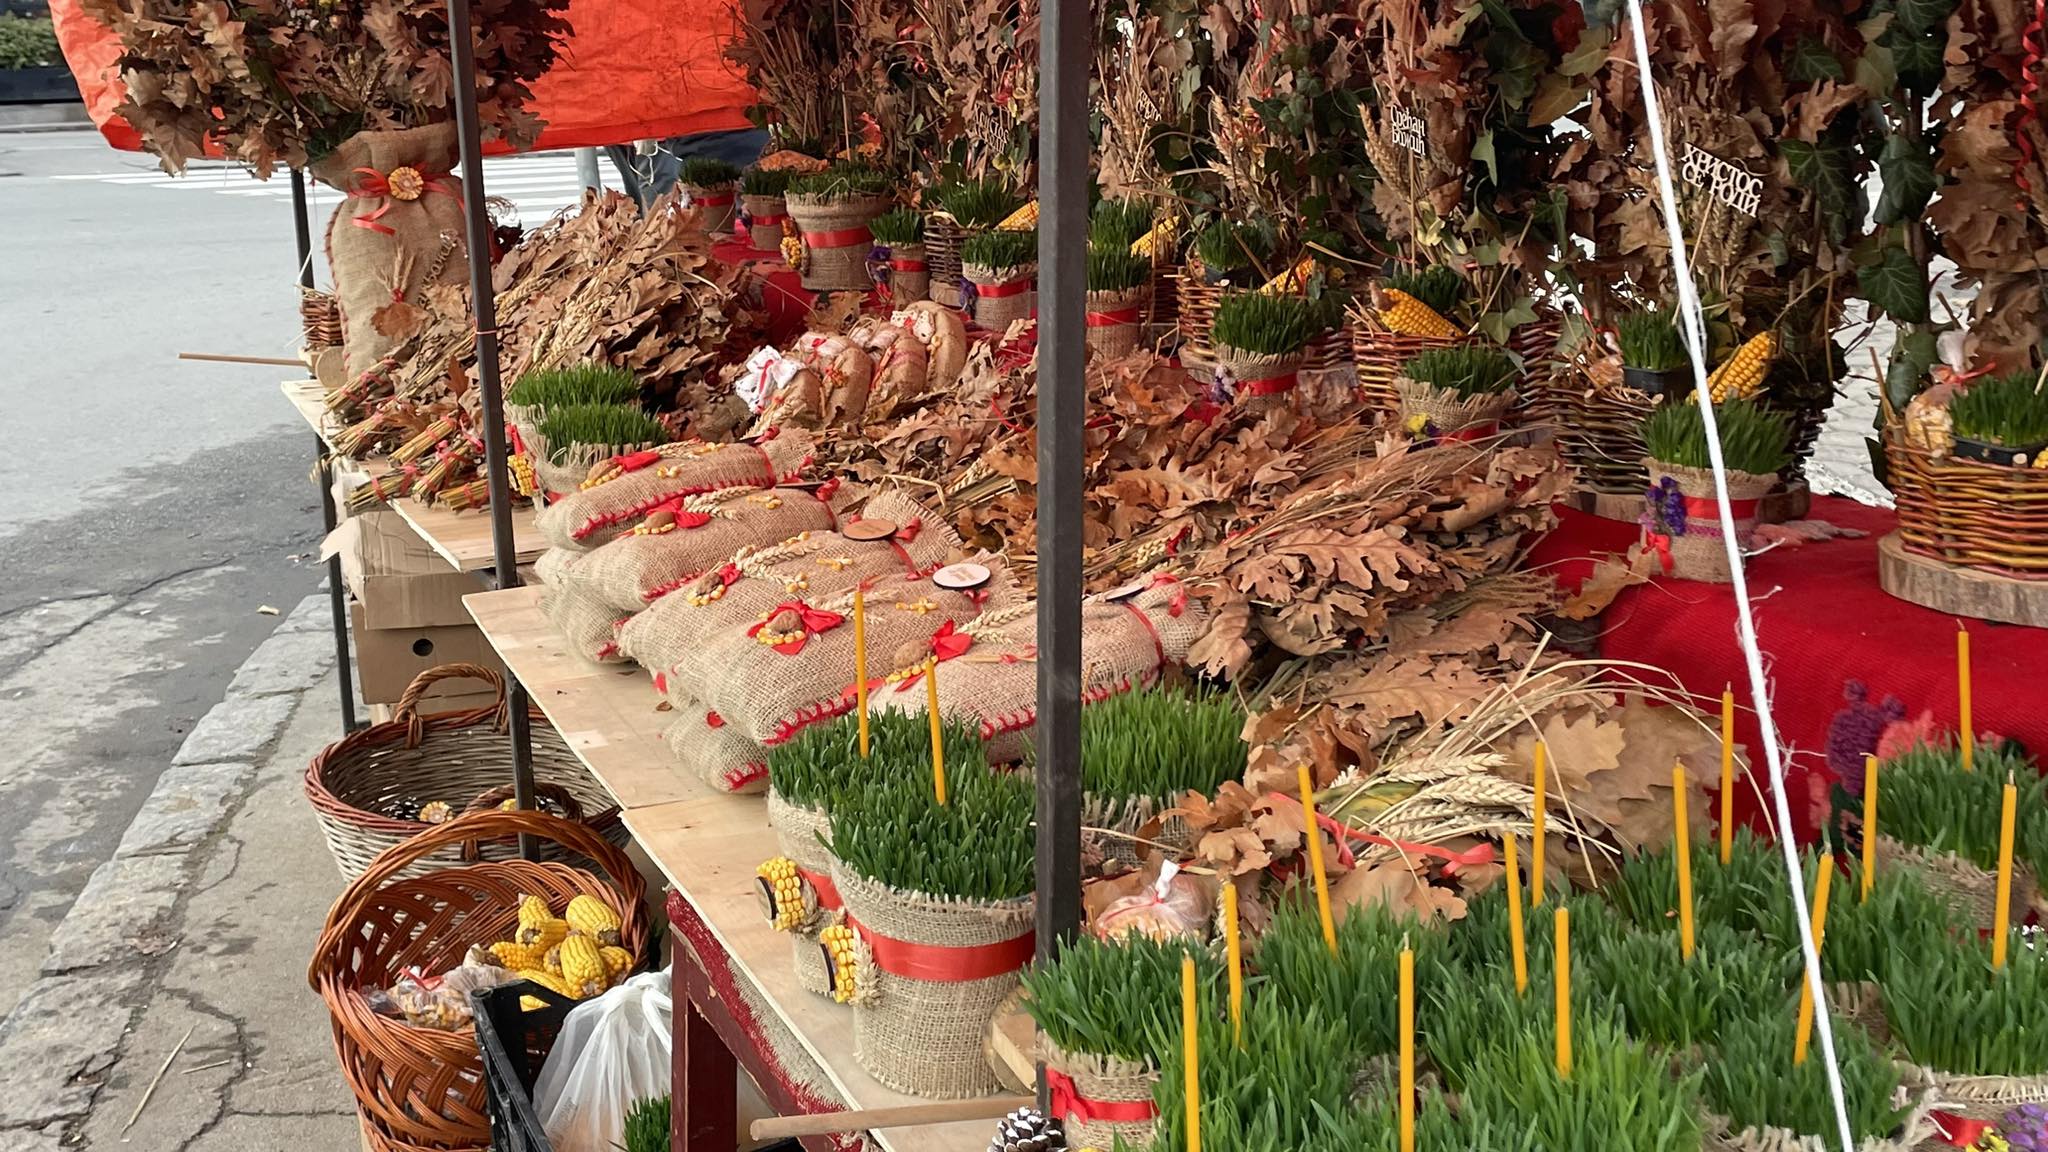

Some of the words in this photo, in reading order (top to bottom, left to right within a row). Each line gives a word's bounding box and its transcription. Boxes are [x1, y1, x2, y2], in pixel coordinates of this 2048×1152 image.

[1681, 142, 1764, 198] ХРИСТОС
[1682, 161, 1704, 188] СЕ
[1709, 180, 1760, 218] РОДИ
